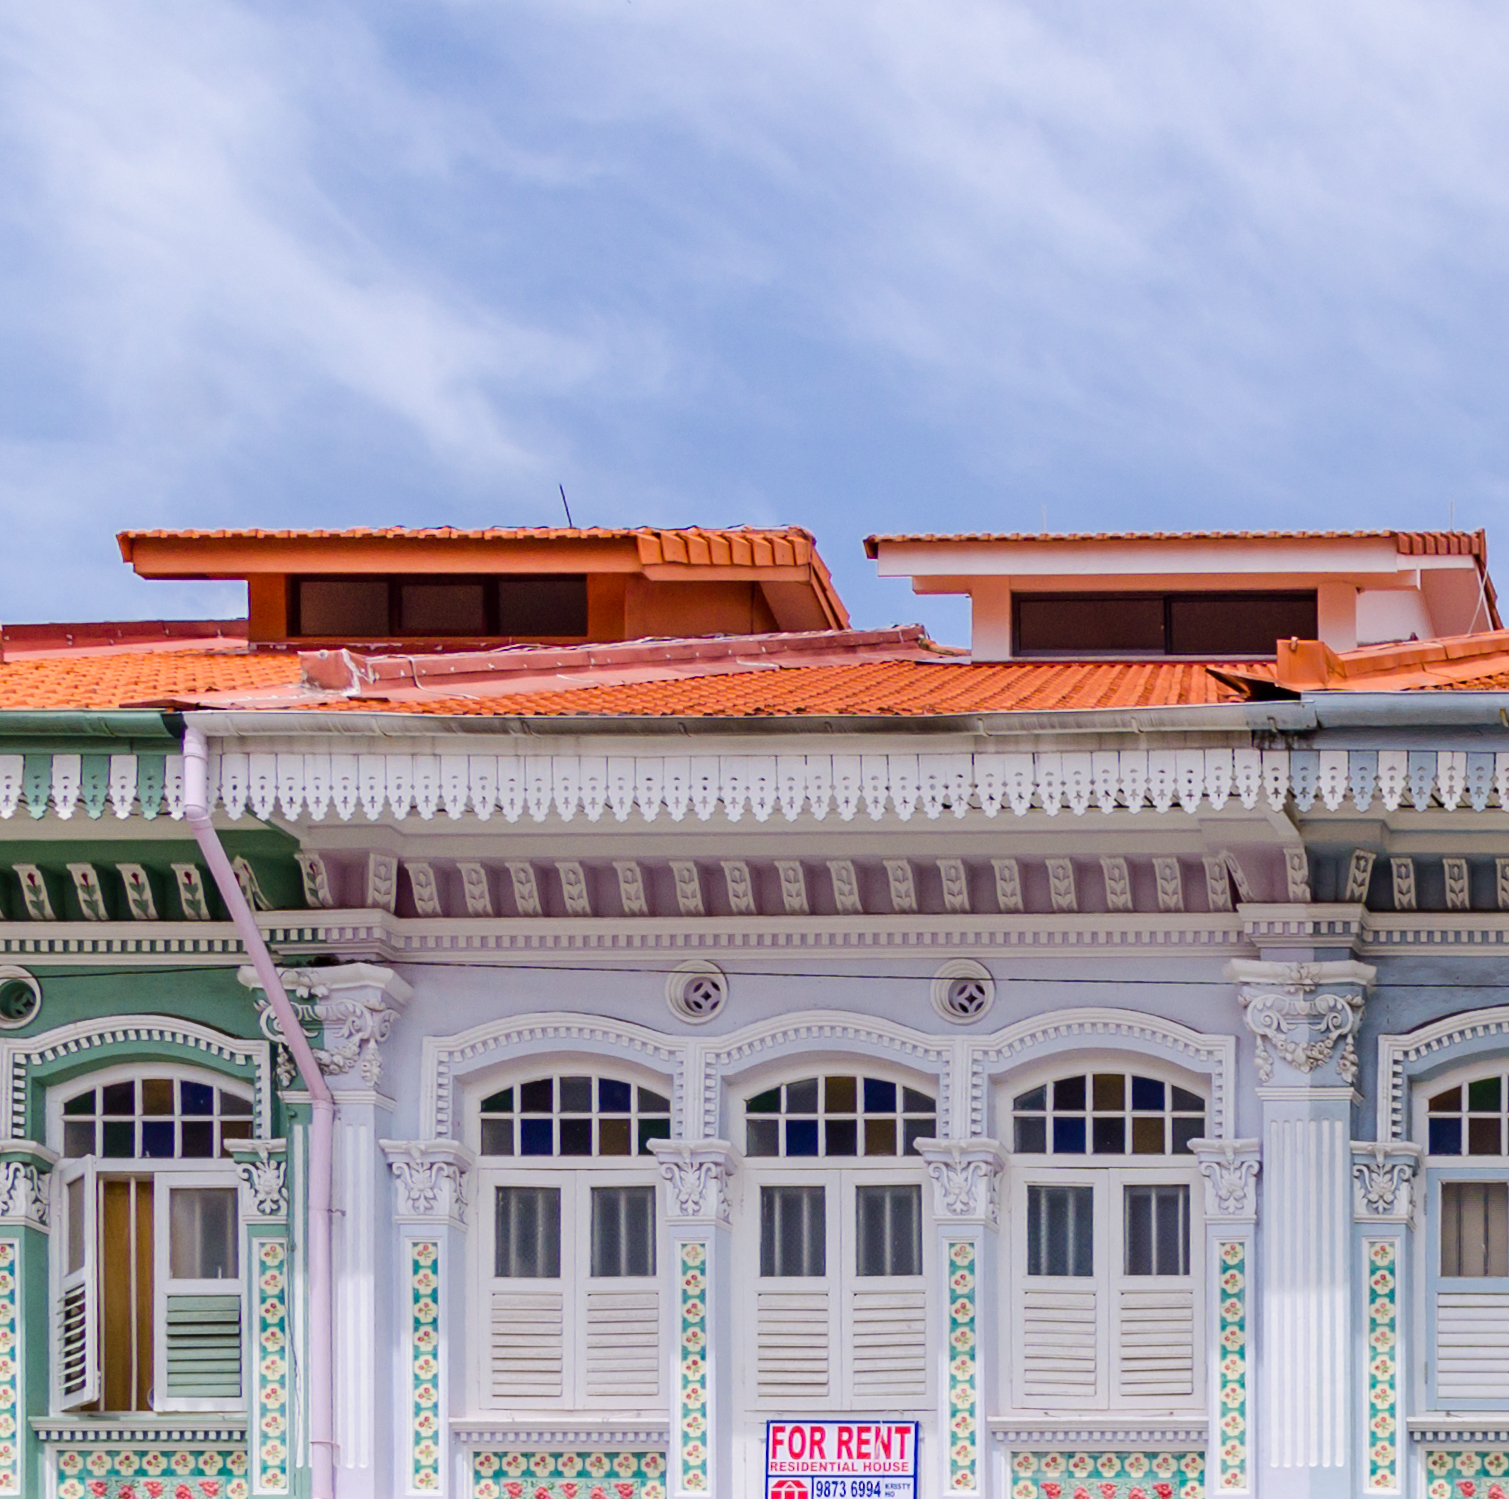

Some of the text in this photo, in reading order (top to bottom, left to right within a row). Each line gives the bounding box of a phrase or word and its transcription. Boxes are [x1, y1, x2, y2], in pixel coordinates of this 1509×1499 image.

[771, 1425, 912, 1460] FOR RENT
[770, 1461, 910, 1472] RESIDENTIAL HOUSE
[815, 1480, 882, 1498] 9873 6994
